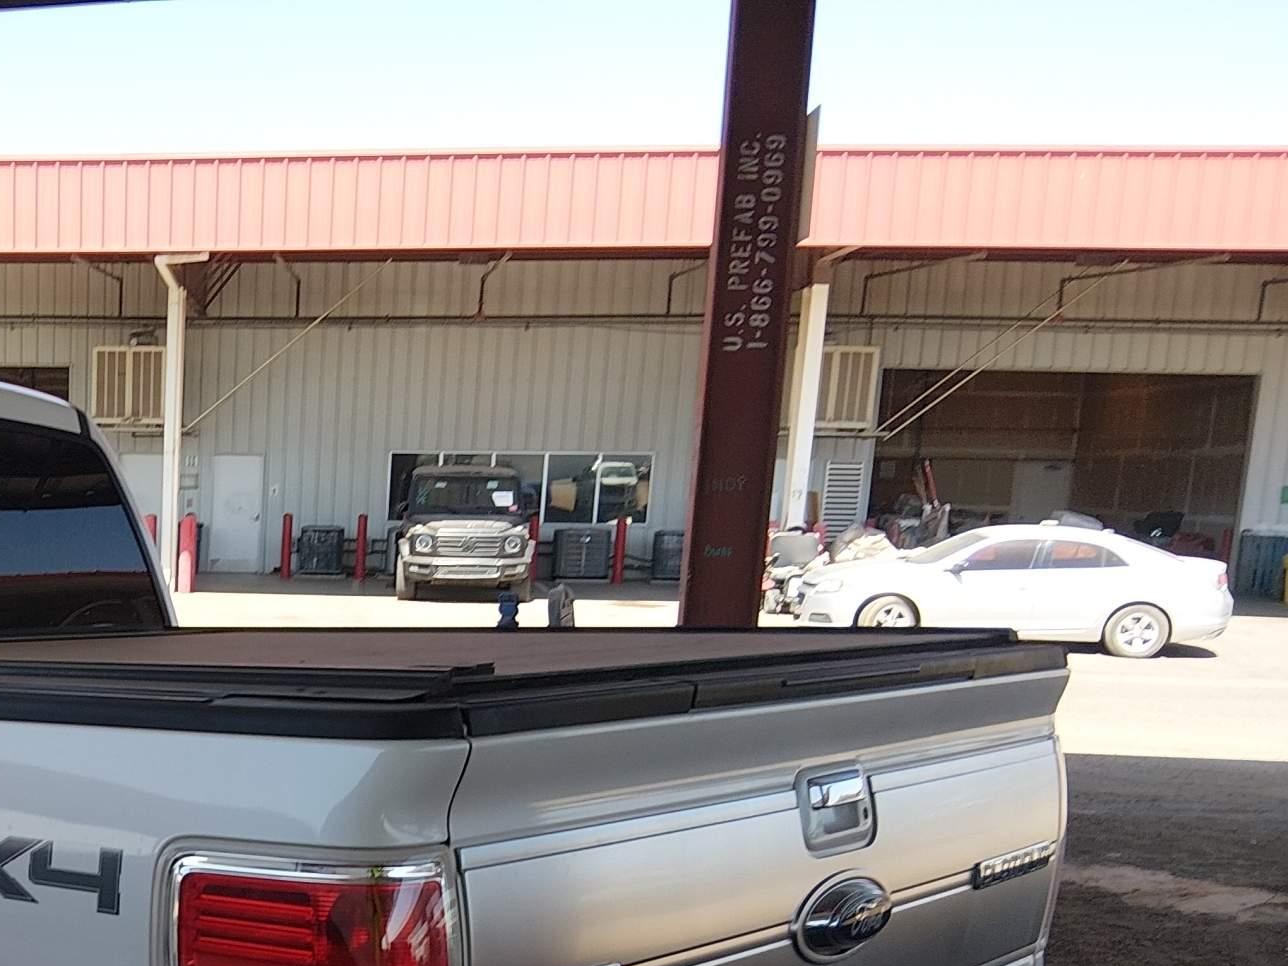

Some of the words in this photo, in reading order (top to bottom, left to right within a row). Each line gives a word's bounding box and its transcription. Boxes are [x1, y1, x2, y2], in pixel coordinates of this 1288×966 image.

[737, 132, 762, 182] INC.
[728, 194, 756, 290] PREFAB
[746, 134, 787, 349] 1-866-799-0969
[722, 304, 746, 351] U.S.
